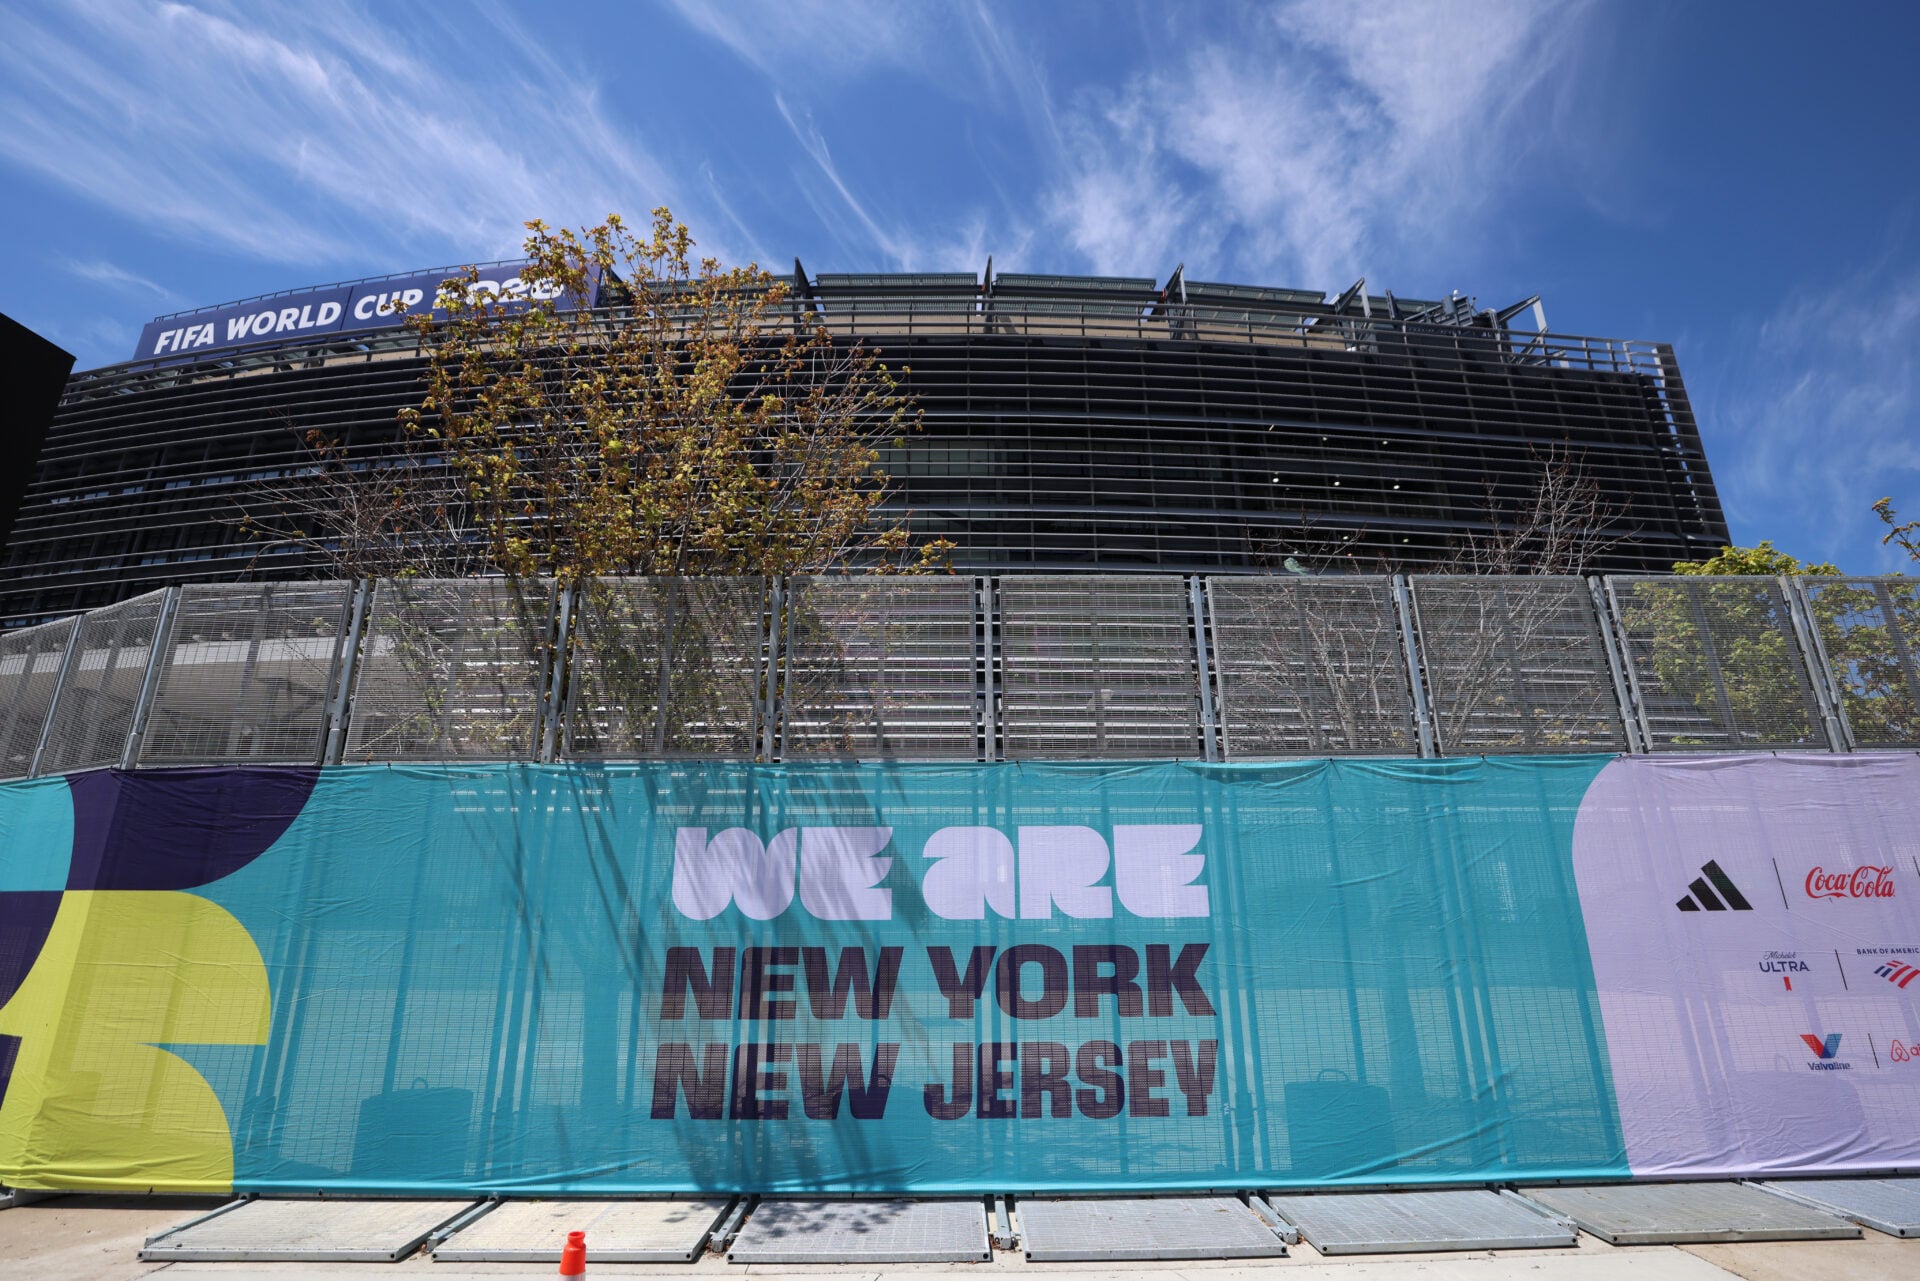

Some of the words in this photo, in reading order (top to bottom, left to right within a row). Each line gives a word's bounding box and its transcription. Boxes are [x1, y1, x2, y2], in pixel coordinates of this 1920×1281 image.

[154, 323, 214, 355] FIFA
[227, 302, 341, 341] WORLD
[354, 288, 424, 321] CUP
[672, 826, 893, 920] WE
[922, 824, 1210, 919] ARE
[1805, 865, 1896, 899] Coca-Cola
[660, 946, 904, 1020] NEW
[926, 943, 1217, 1018] YORK
[1759, 961, 1811, 973] ULTRA
[650, 1042, 900, 1120] NEW
[923, 1039, 1219, 1119] JERSEY
[1807, 1061, 1851, 1071] Valvoline
